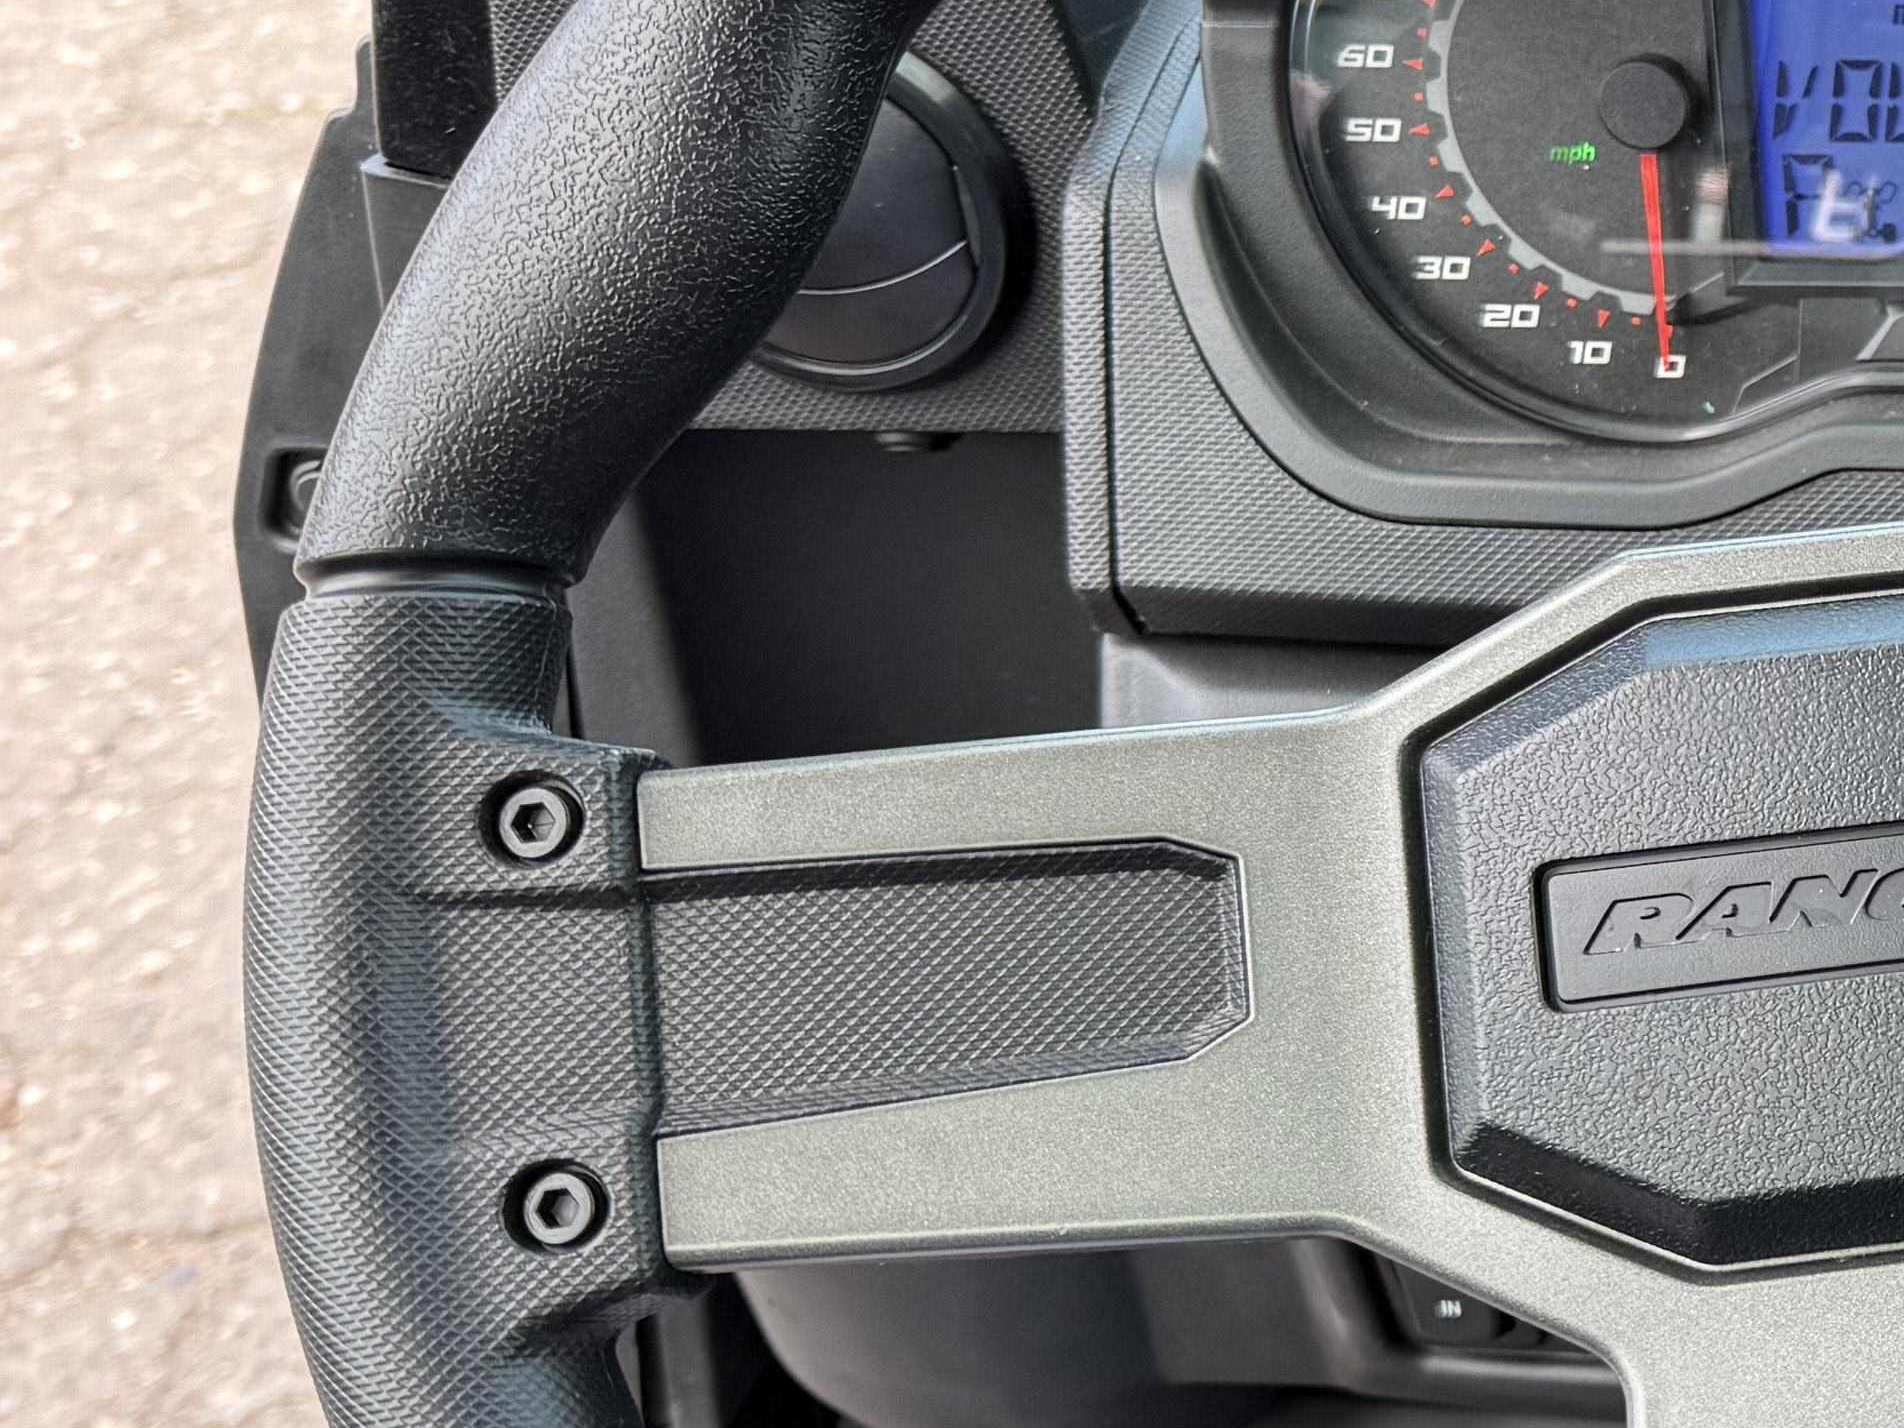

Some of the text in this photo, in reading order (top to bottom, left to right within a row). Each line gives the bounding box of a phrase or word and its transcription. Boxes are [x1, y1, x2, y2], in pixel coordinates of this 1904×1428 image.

[1336, 44, 1395, 68] 60
[1344, 118, 1402, 142] 50
[1549, 141, 1597, 164] mph
[1370, 196, 1426, 220] 40
[1414, 256, 1471, 281] 30
[1480, 303, 1540, 328] 20
[1568, 340, 1613, 365] 10
[1655, 355, 1687, 379] 0
